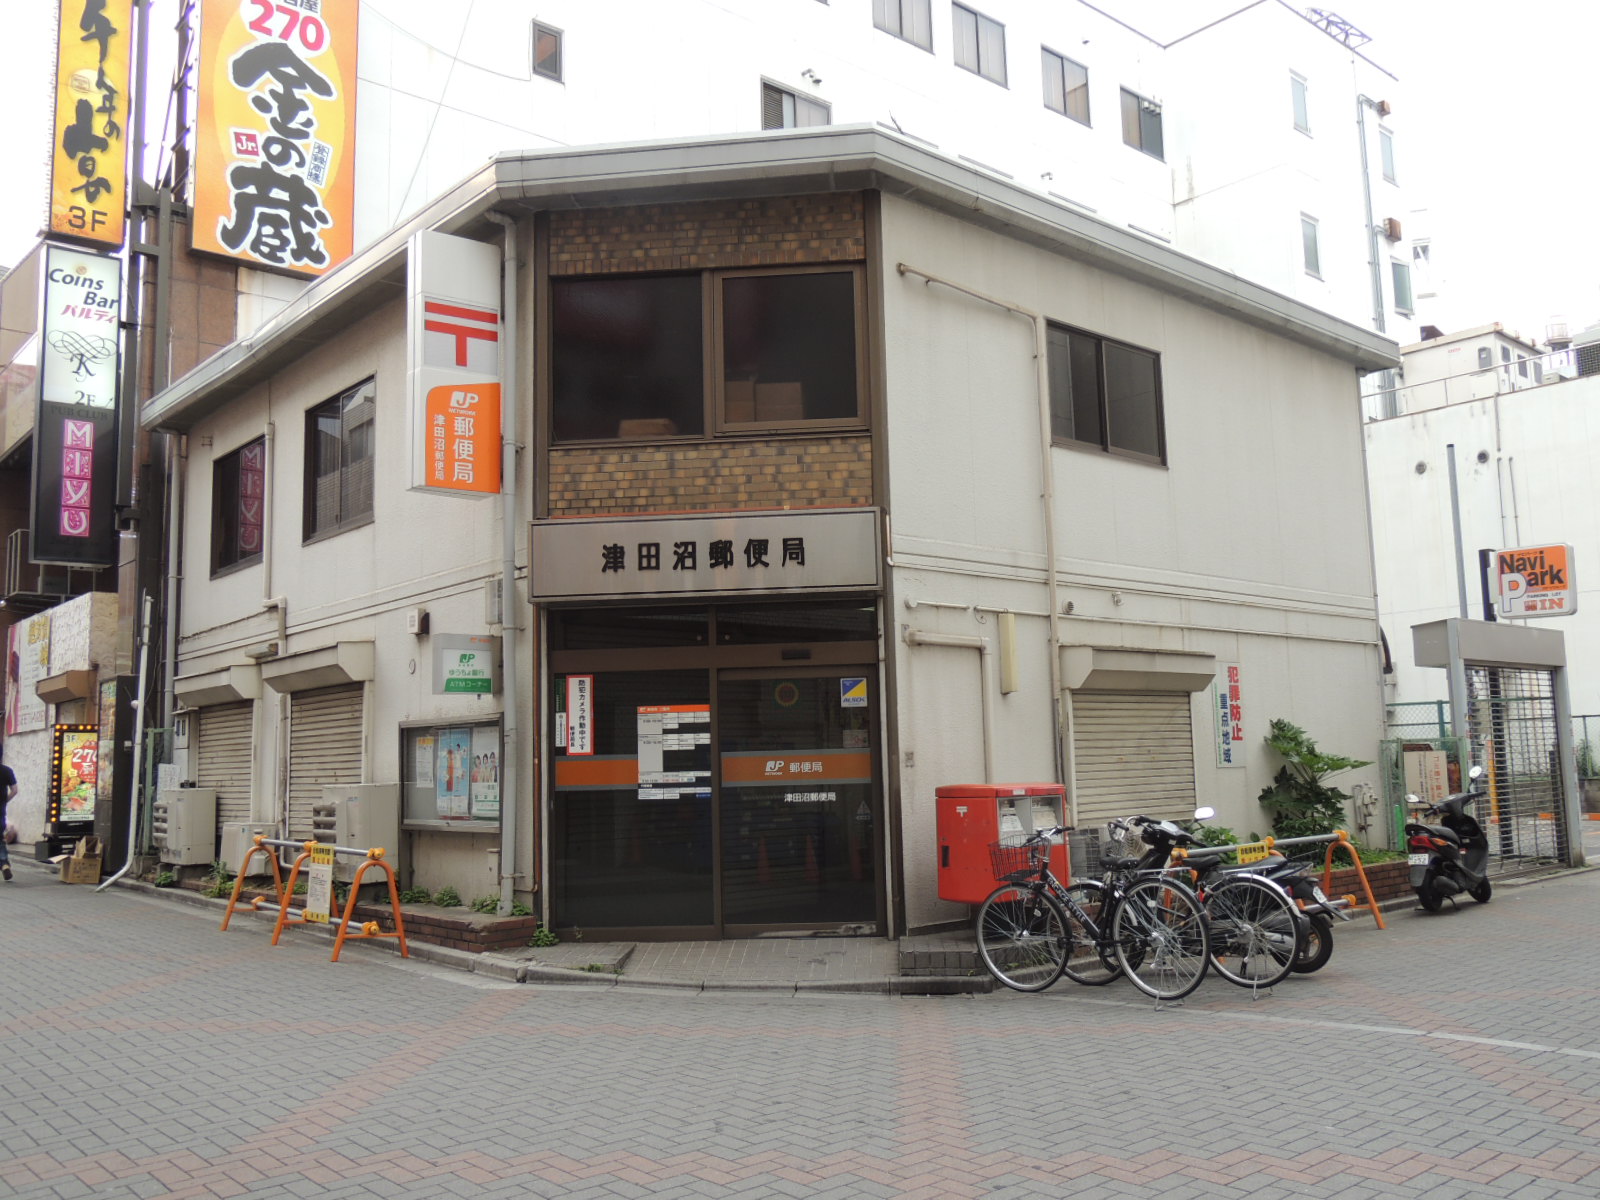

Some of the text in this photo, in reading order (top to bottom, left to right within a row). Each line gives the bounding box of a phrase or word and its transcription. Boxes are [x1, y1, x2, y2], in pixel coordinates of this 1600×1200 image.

[248, 0, 325, 51] 270
[220, 43, 333, 264] 金の蔵
[237, 135, 258, 152] Jr.
[67, 205, 108, 232] 3F
[49, 268, 104, 290] Coins
[83, 291, 119, 309] Bar
[75, 390, 96, 408] 2F
[433, 413, 447, 481] 津田沼郵便局
[453, 416, 475, 484] 郵便局
[61, 421, 92, 534] MIYU
[601, 537, 805, 573] 津田沼郵便局
[1499, 551, 1545, 573] Navi
[1501, 565, 1563, 612] Park
[1539, 598, 1564, 610] IN
[459, 653, 476, 664] JP
[1227, 666, 1243, 741] 犯罪防止
[765, 760, 785, 770] JP
[789, 762, 823, 773] 郵便局
[784, 792, 837, 803] 津田沼郵便局
